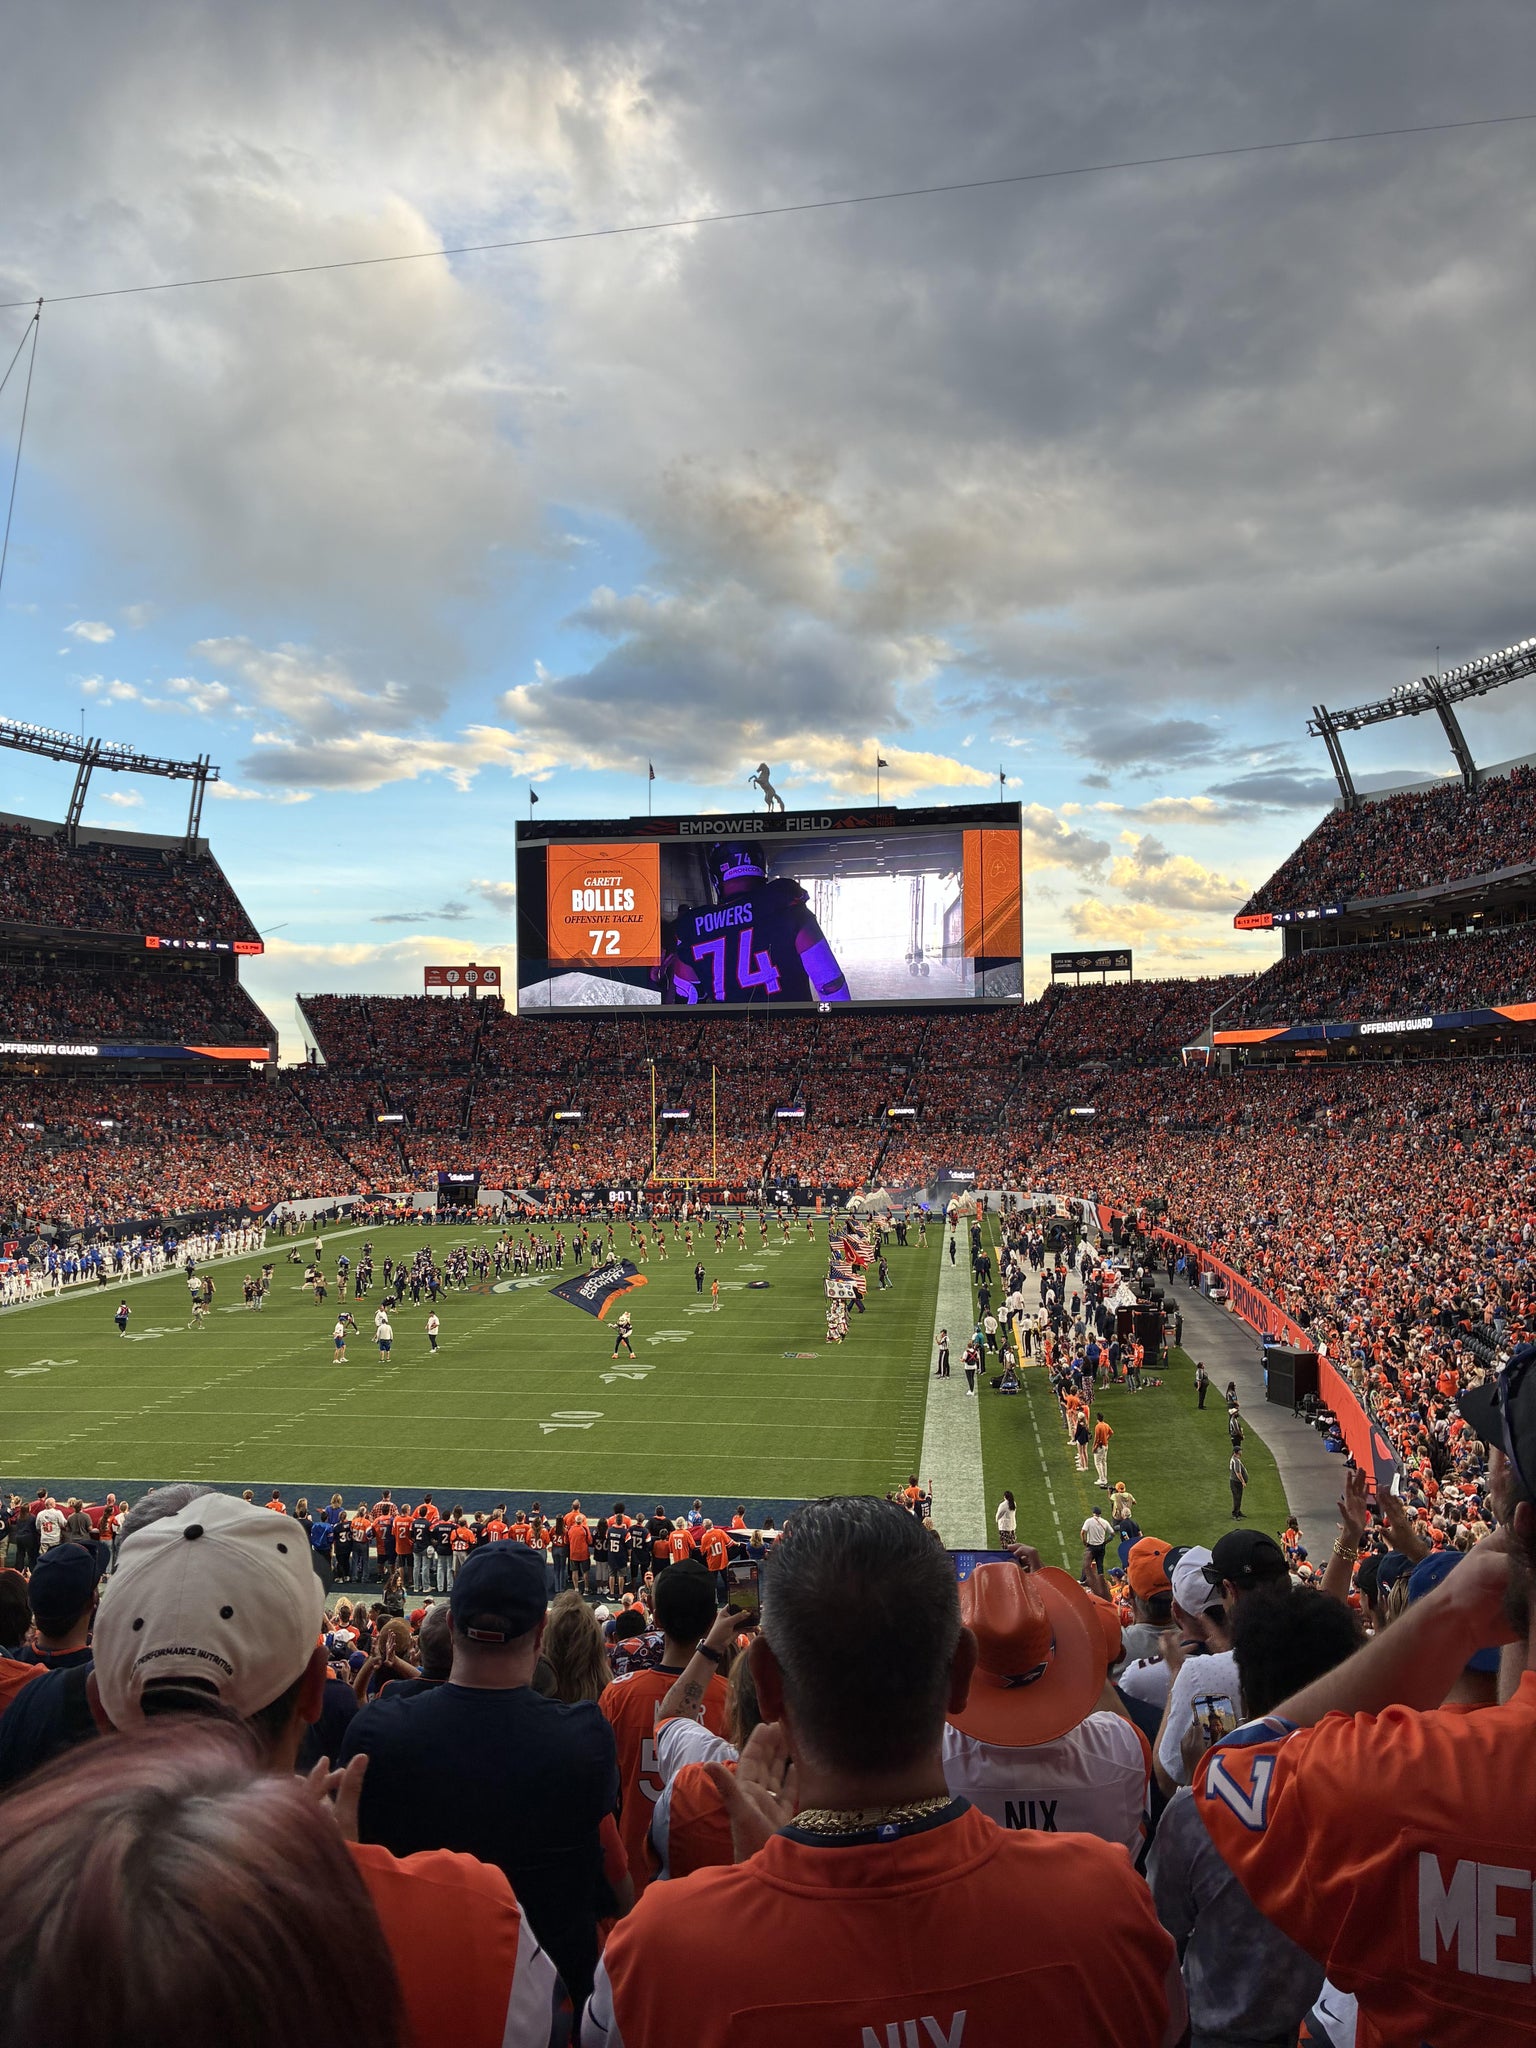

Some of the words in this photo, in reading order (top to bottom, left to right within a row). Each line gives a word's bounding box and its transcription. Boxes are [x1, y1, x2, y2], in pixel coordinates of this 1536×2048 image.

[679, 819, 764, 835] EMPOWER
[786, 816, 832, 831] FIELD
[734, 853, 751, 866] 74
[728, 866, 760, 876] BRONCOS
[583, 876, 623, 887] GARETT
[571, 888, 635, 912] BOLLES
[564, 915, 611, 924] OFFENSIVE
[612, 914, 644, 923] TACKLE
[695, 903, 753, 936] POWERS
[588, 930, 621, 955] 72
[692, 927, 782, 1001] 74
[1360, 1021, 1406, 1034] OFFENSIVE
[1406, 1018, 1433, 1030] GUARD
[0, 1043, 57, 1055] OFFENSIVE
[57, 1045, 98, 1056] GUARD
[609, 1191, 632, 1202] 8:07
[1233, 1278, 1268, 1333] BRONCOS
[415, 1528, 423, 1540] 2
[441, 1533, 449, 1544] 2
[552, 1534, 563, 1544] 24
[530, 1538, 543, 1549] 30
[610, 1540, 620, 1553] 15
[631, 1536, 643, 1549] 12
[673, 1538, 683, 1550] 18
[710, 1541, 723, 1556] 10
[137, 1647, 197, 1666] PERFORMANCE
[1005, 1799, 1058, 1833] NIX
[1418, 1851, 1536, 1984] ME
